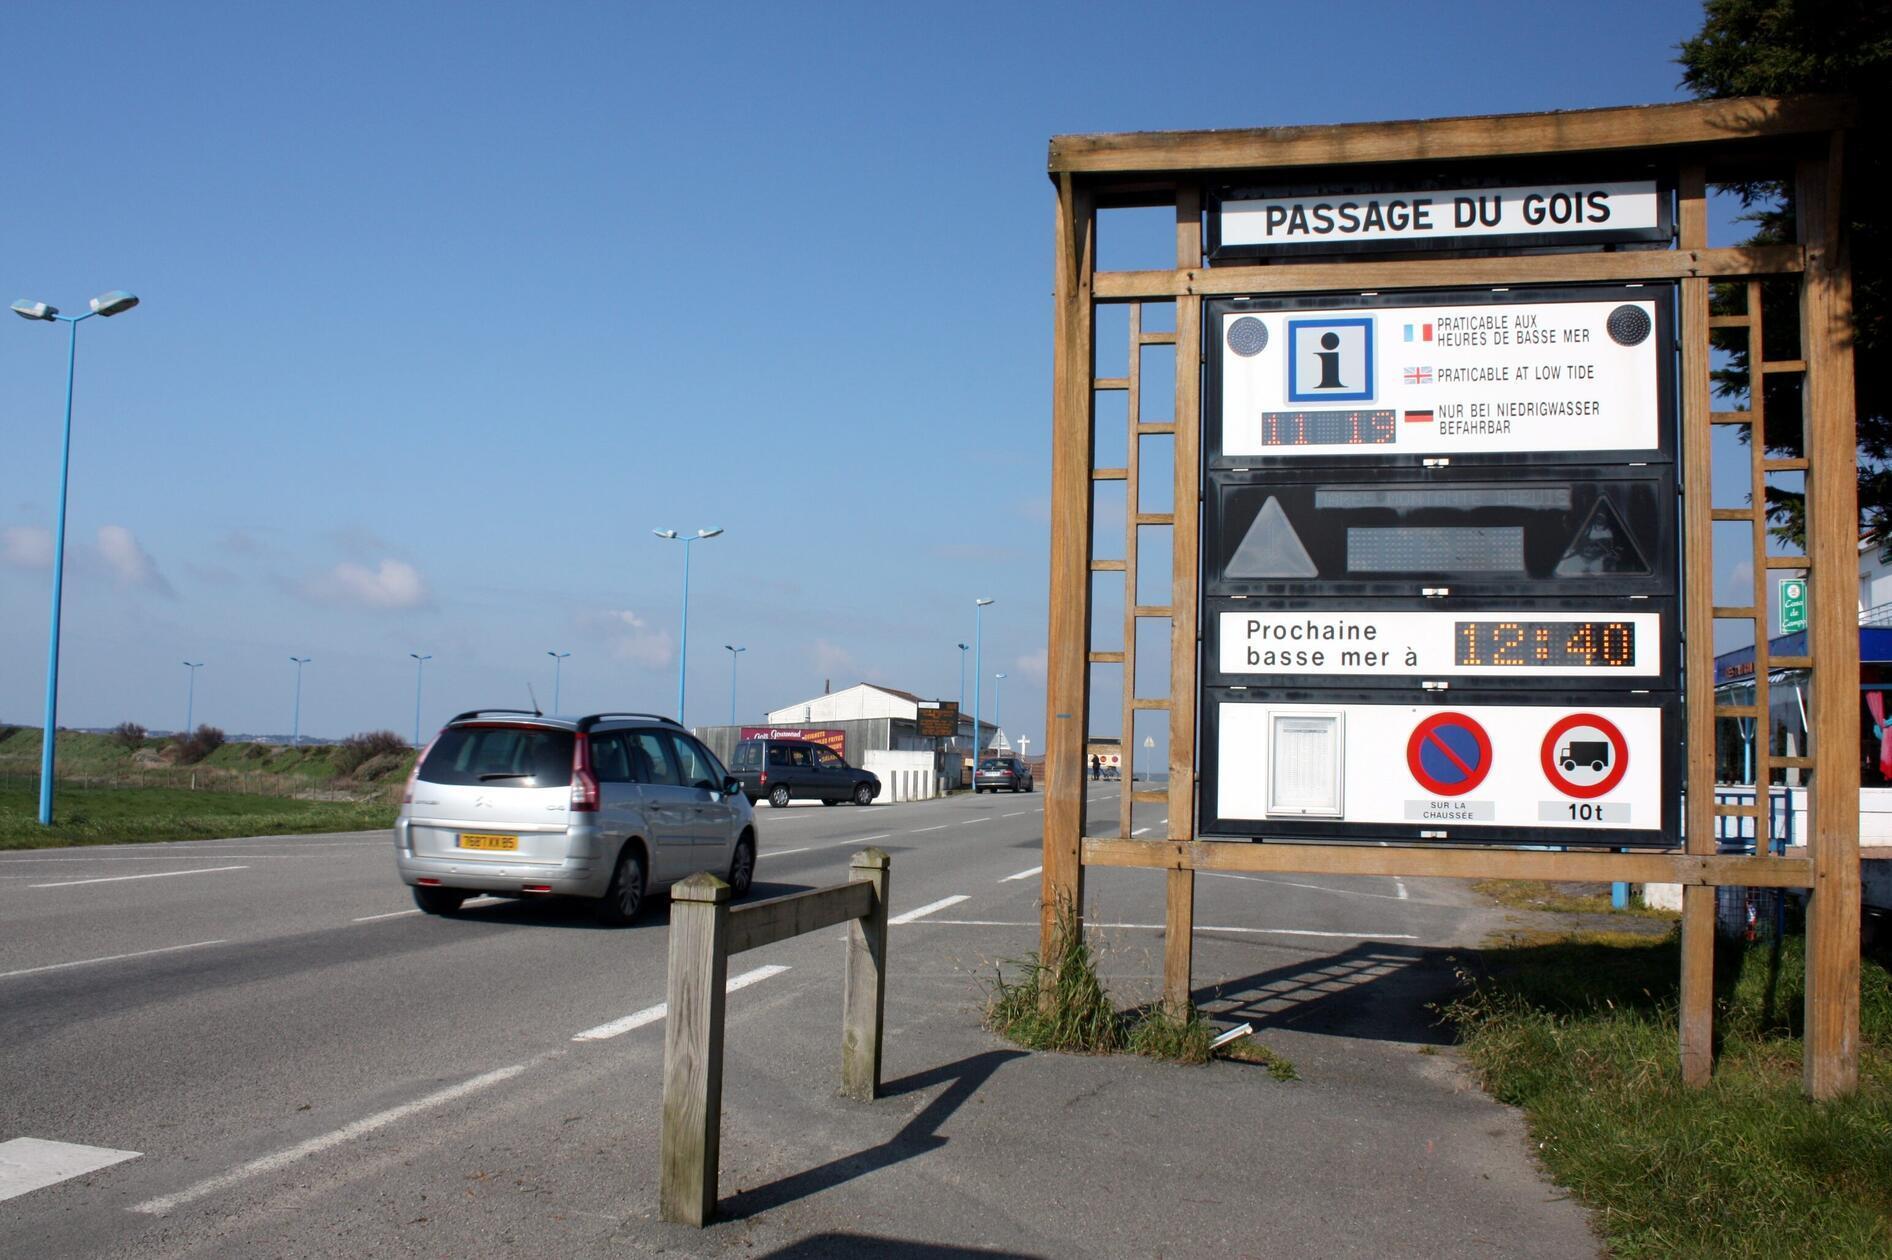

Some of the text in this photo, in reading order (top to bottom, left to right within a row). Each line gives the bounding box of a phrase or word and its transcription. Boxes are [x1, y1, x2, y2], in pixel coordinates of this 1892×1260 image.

[1265, 190, 1612, 236] PASSAGE DU GOIS
[1437, 314, 1537, 331] PRATICABLE AUX
[1438, 328, 1590, 347] HEURES DE BASSE MER
[1438, 364, 1595, 382] PRATICABLE AT LOW TIDE
[1439, 401, 1600, 418] NUR BEI NIEDRIGWASSER
[1439, 419, 1511, 435] BEFAHRBAR
[1247, 620, 1378, 641] Prochaine
[1463, 623, 1628, 665] 12:40
[1247, 646, 1418, 667] basse mer à
[1568, 803, 1603, 821] 10t
